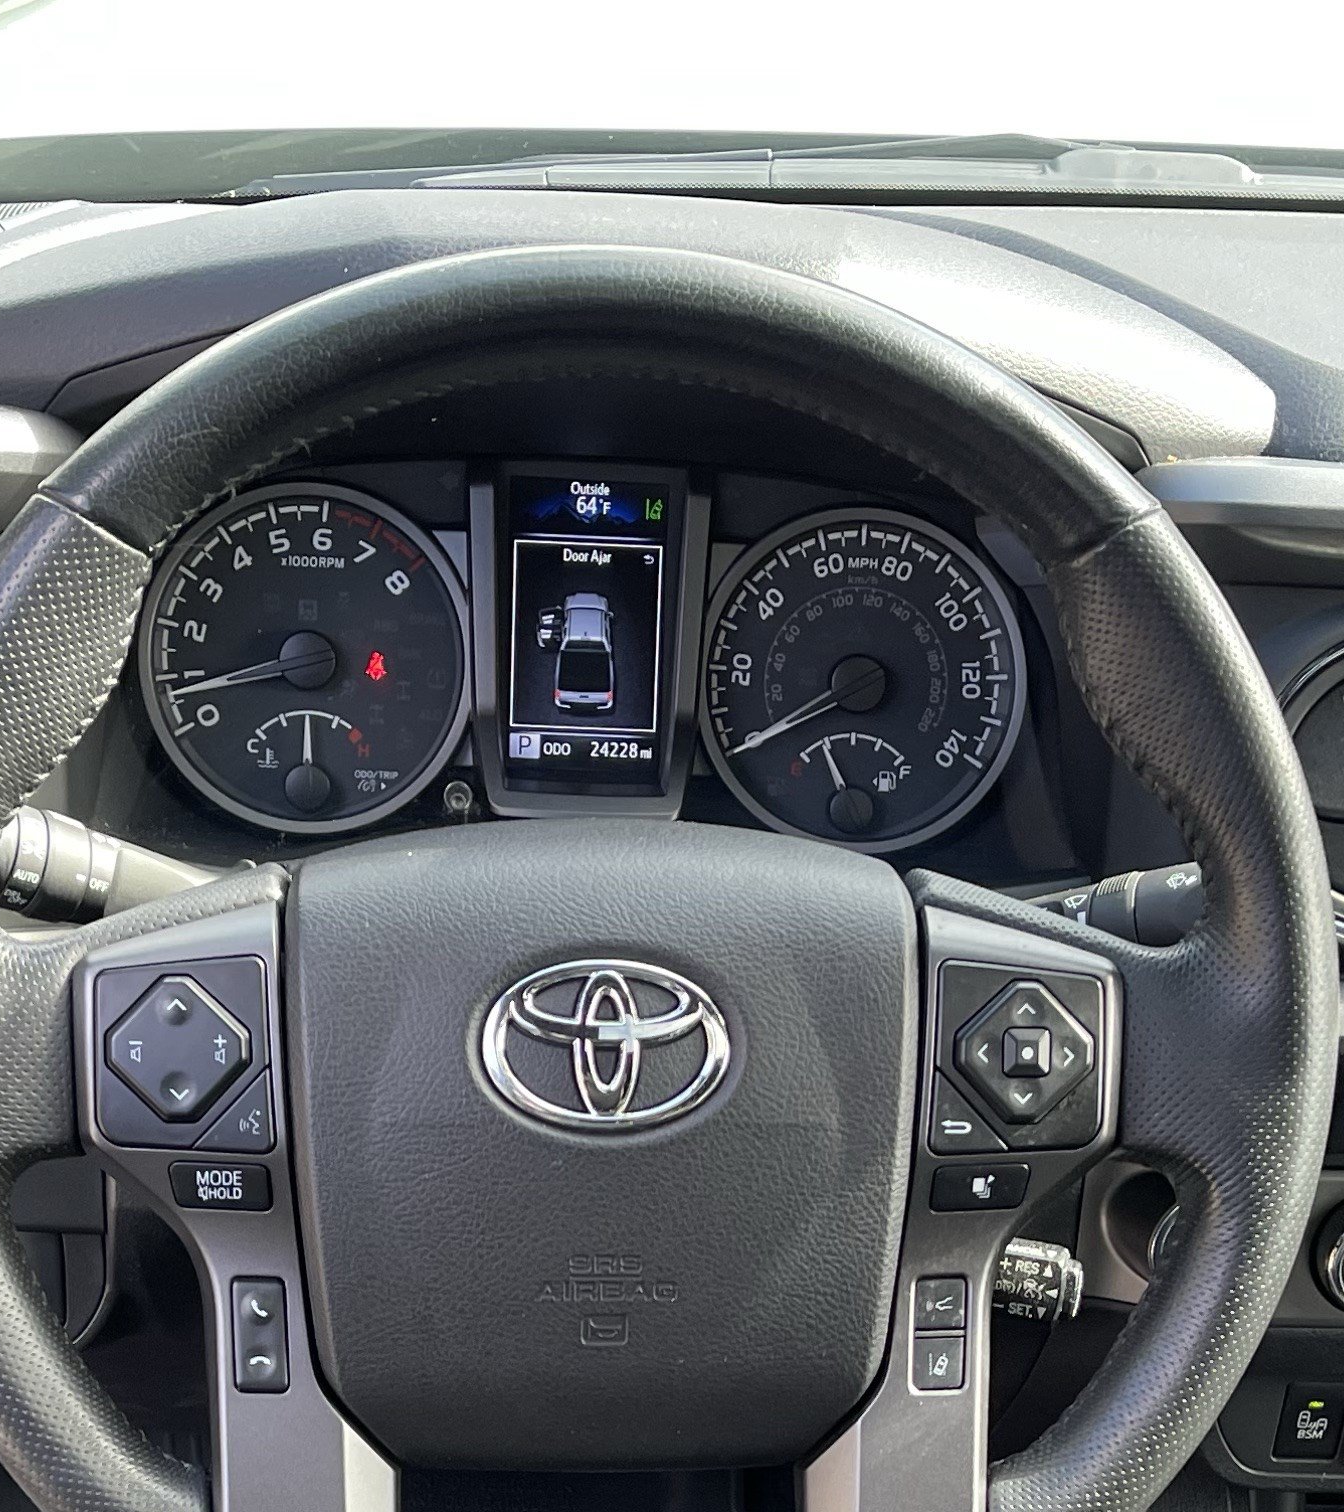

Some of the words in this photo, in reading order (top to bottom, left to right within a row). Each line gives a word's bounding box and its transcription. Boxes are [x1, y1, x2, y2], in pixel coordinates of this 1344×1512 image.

[570, 481, 610, 496] Outside
[268, 529, 290, 554] 5
[312, 528, 332, 550] 6
[232, 546, 252, 572] 4
[353, 539, 378, 564] 7
[563, 548, 588, 563] Door
[591, 549, 612, 564] Ajar
[813, 552, 846, 578] 60
[847, 557, 879, 571] MPH
[881, 555, 914, 582] 80
[200, 577, 224, 603] 3
[384, 569, 410, 596] 8
[847, 574, 879, 585] km/h
[757, 587, 785, 620] 40
[934, 592, 968, 632] 100
[183, 620, 208, 643] 2
[182, 668, 206, 679] 1
[731, 653, 752, 686] 20
[961, 660, 982, 700] 120
[196, 703, 220, 727] 0
[246, 738, 260, 754] C
[358, 744, 370, 757] H
[543, 742, 571, 756] ODO
[590, 741, 638, 759] 24228
[640, 747, 652, 760] mi
[935, 728, 968, 768] 140
[899, 764, 912, 780] F
[12, 868, 40, 884] AUTO
[88, 877, 110, 892] OFF
[196, 1170, 243, 1187] MODE
[208, 1186, 243, 1200] HOLD
[568, 1254, 644, 1275] SRS
[1014, 1260, 1041, 1275] RES
[535, 1280, 678, 1302] AIRBAG
[1296, 1430, 1324, 1440] BSM
